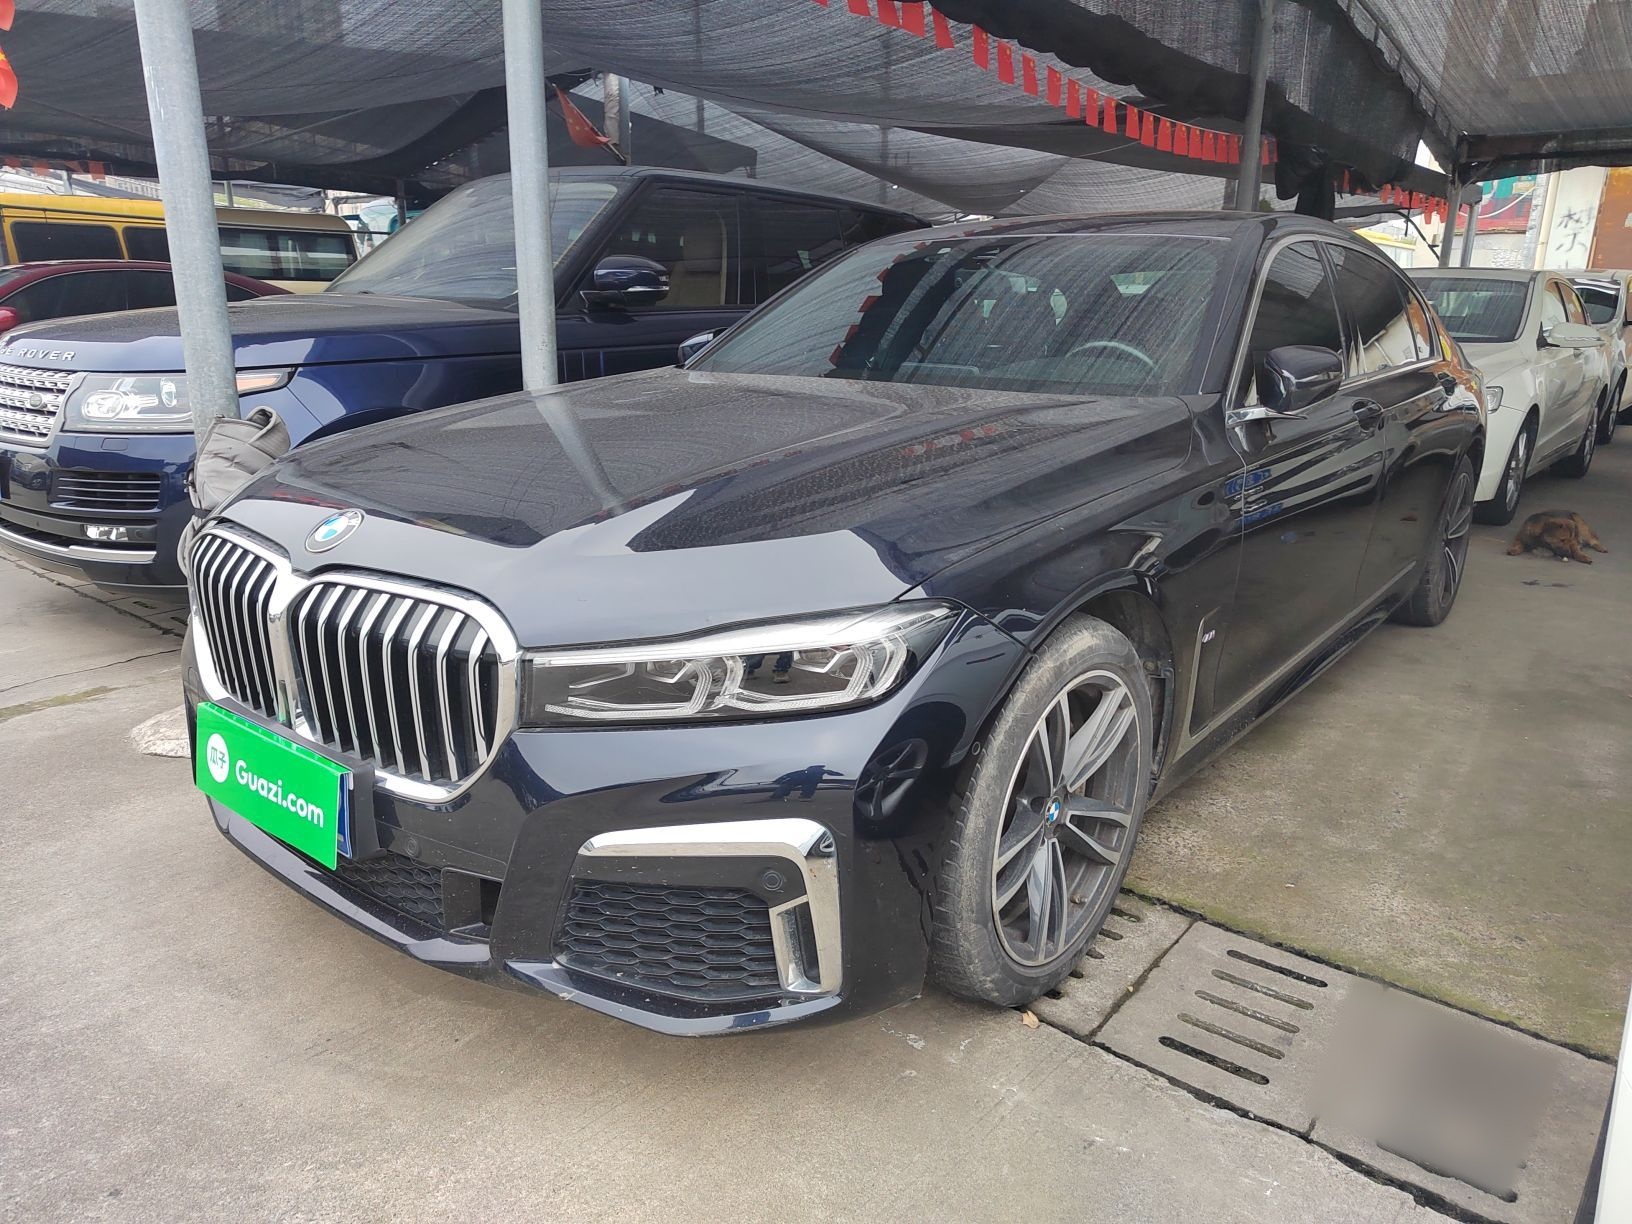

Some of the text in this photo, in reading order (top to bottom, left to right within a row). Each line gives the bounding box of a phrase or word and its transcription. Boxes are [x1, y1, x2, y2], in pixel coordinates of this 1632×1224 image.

[18, 348, 76, 361] ROVER
[209, 746, 227, 769] 瓜子
[235, 759, 324, 828] Guazi.com
